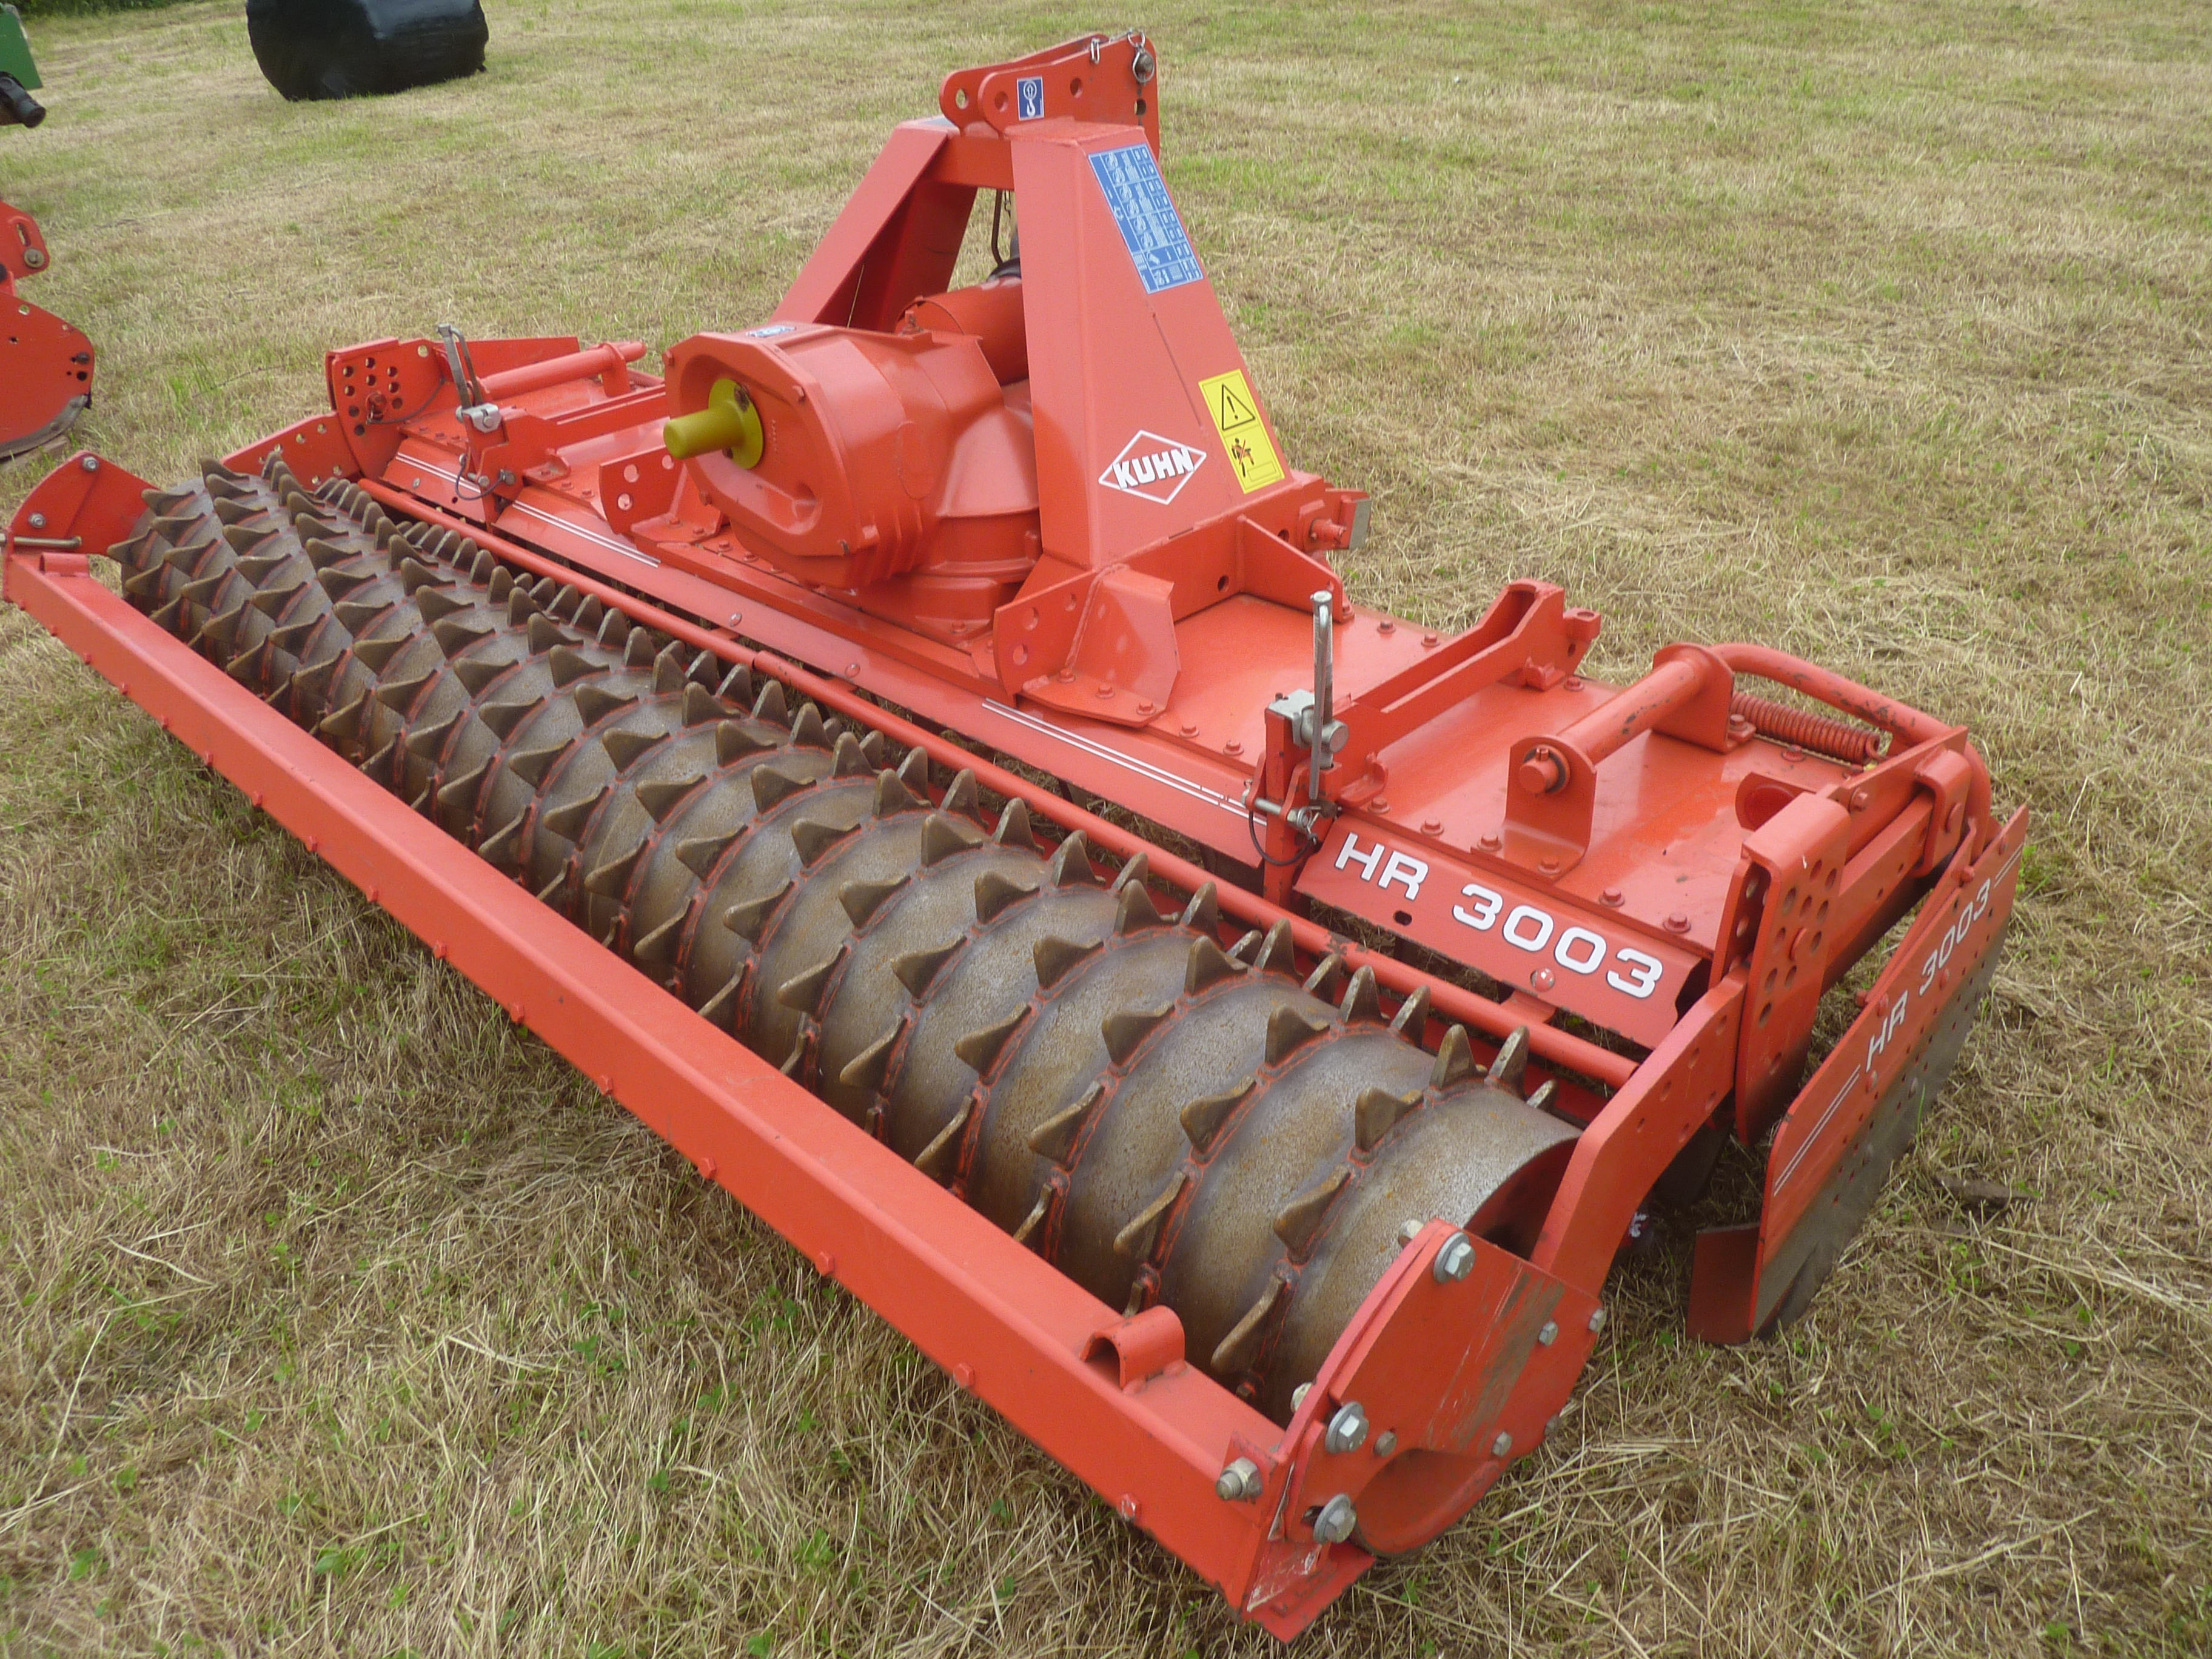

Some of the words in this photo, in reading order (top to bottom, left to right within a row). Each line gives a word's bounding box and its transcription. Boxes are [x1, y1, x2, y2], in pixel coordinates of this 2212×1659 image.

[1113, 448, 1195, 489] KUHN
[1335, 833, 1429, 900] HR
[1453, 885, 1663, 998] 3003
[1866, 991, 1908, 1072] HR
[1920, 879, 1991, 995] 3003
